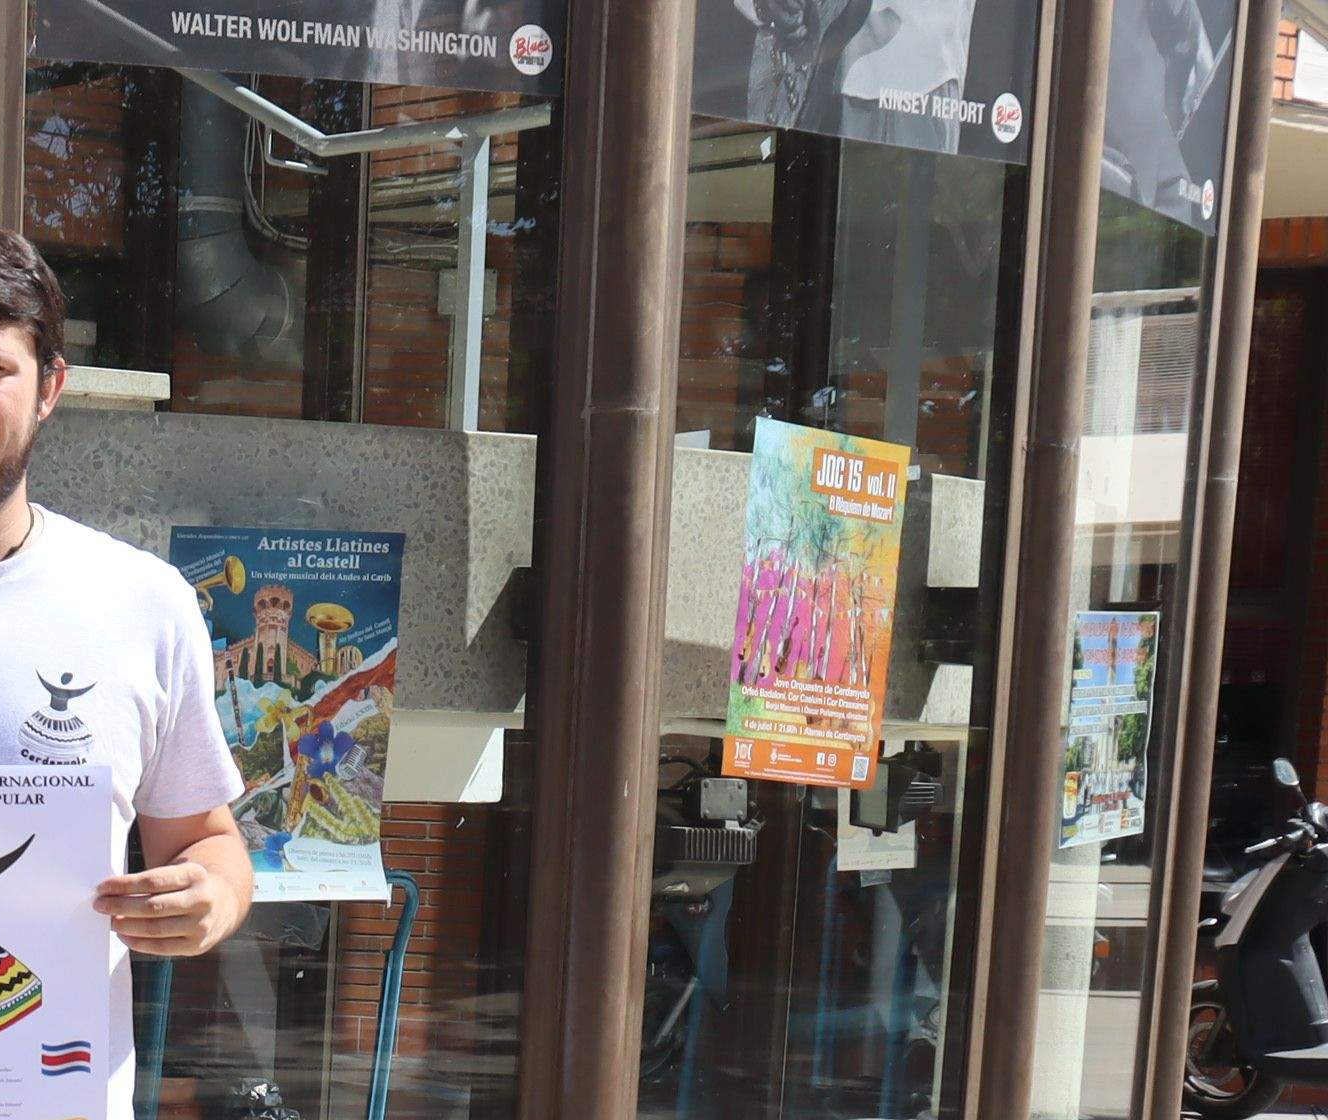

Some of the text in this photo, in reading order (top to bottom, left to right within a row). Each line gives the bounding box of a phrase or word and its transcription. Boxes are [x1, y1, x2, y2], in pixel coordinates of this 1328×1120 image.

[171, 11, 498, 58] WALTER WOLFMAN WASHINGTON
[878, 87, 986, 126] KINSEY REPORT
[816, 453, 845, 490] JOC
[847, 459, 864, 493] 15
[867, 471, 886, 498] vol.
[257, 536, 323, 552] Artistes
[325, 538, 391, 555] Llatines
[287, 553, 361, 570] al Castell
[251, 570, 263, 579] Un
[263, 570, 288, 582] viatge
[288, 571, 319, 581] musical
[320, 572, 336, 582] dels
[336, 573, 361, 583] Andes
[362, 573, 370, 582] al
